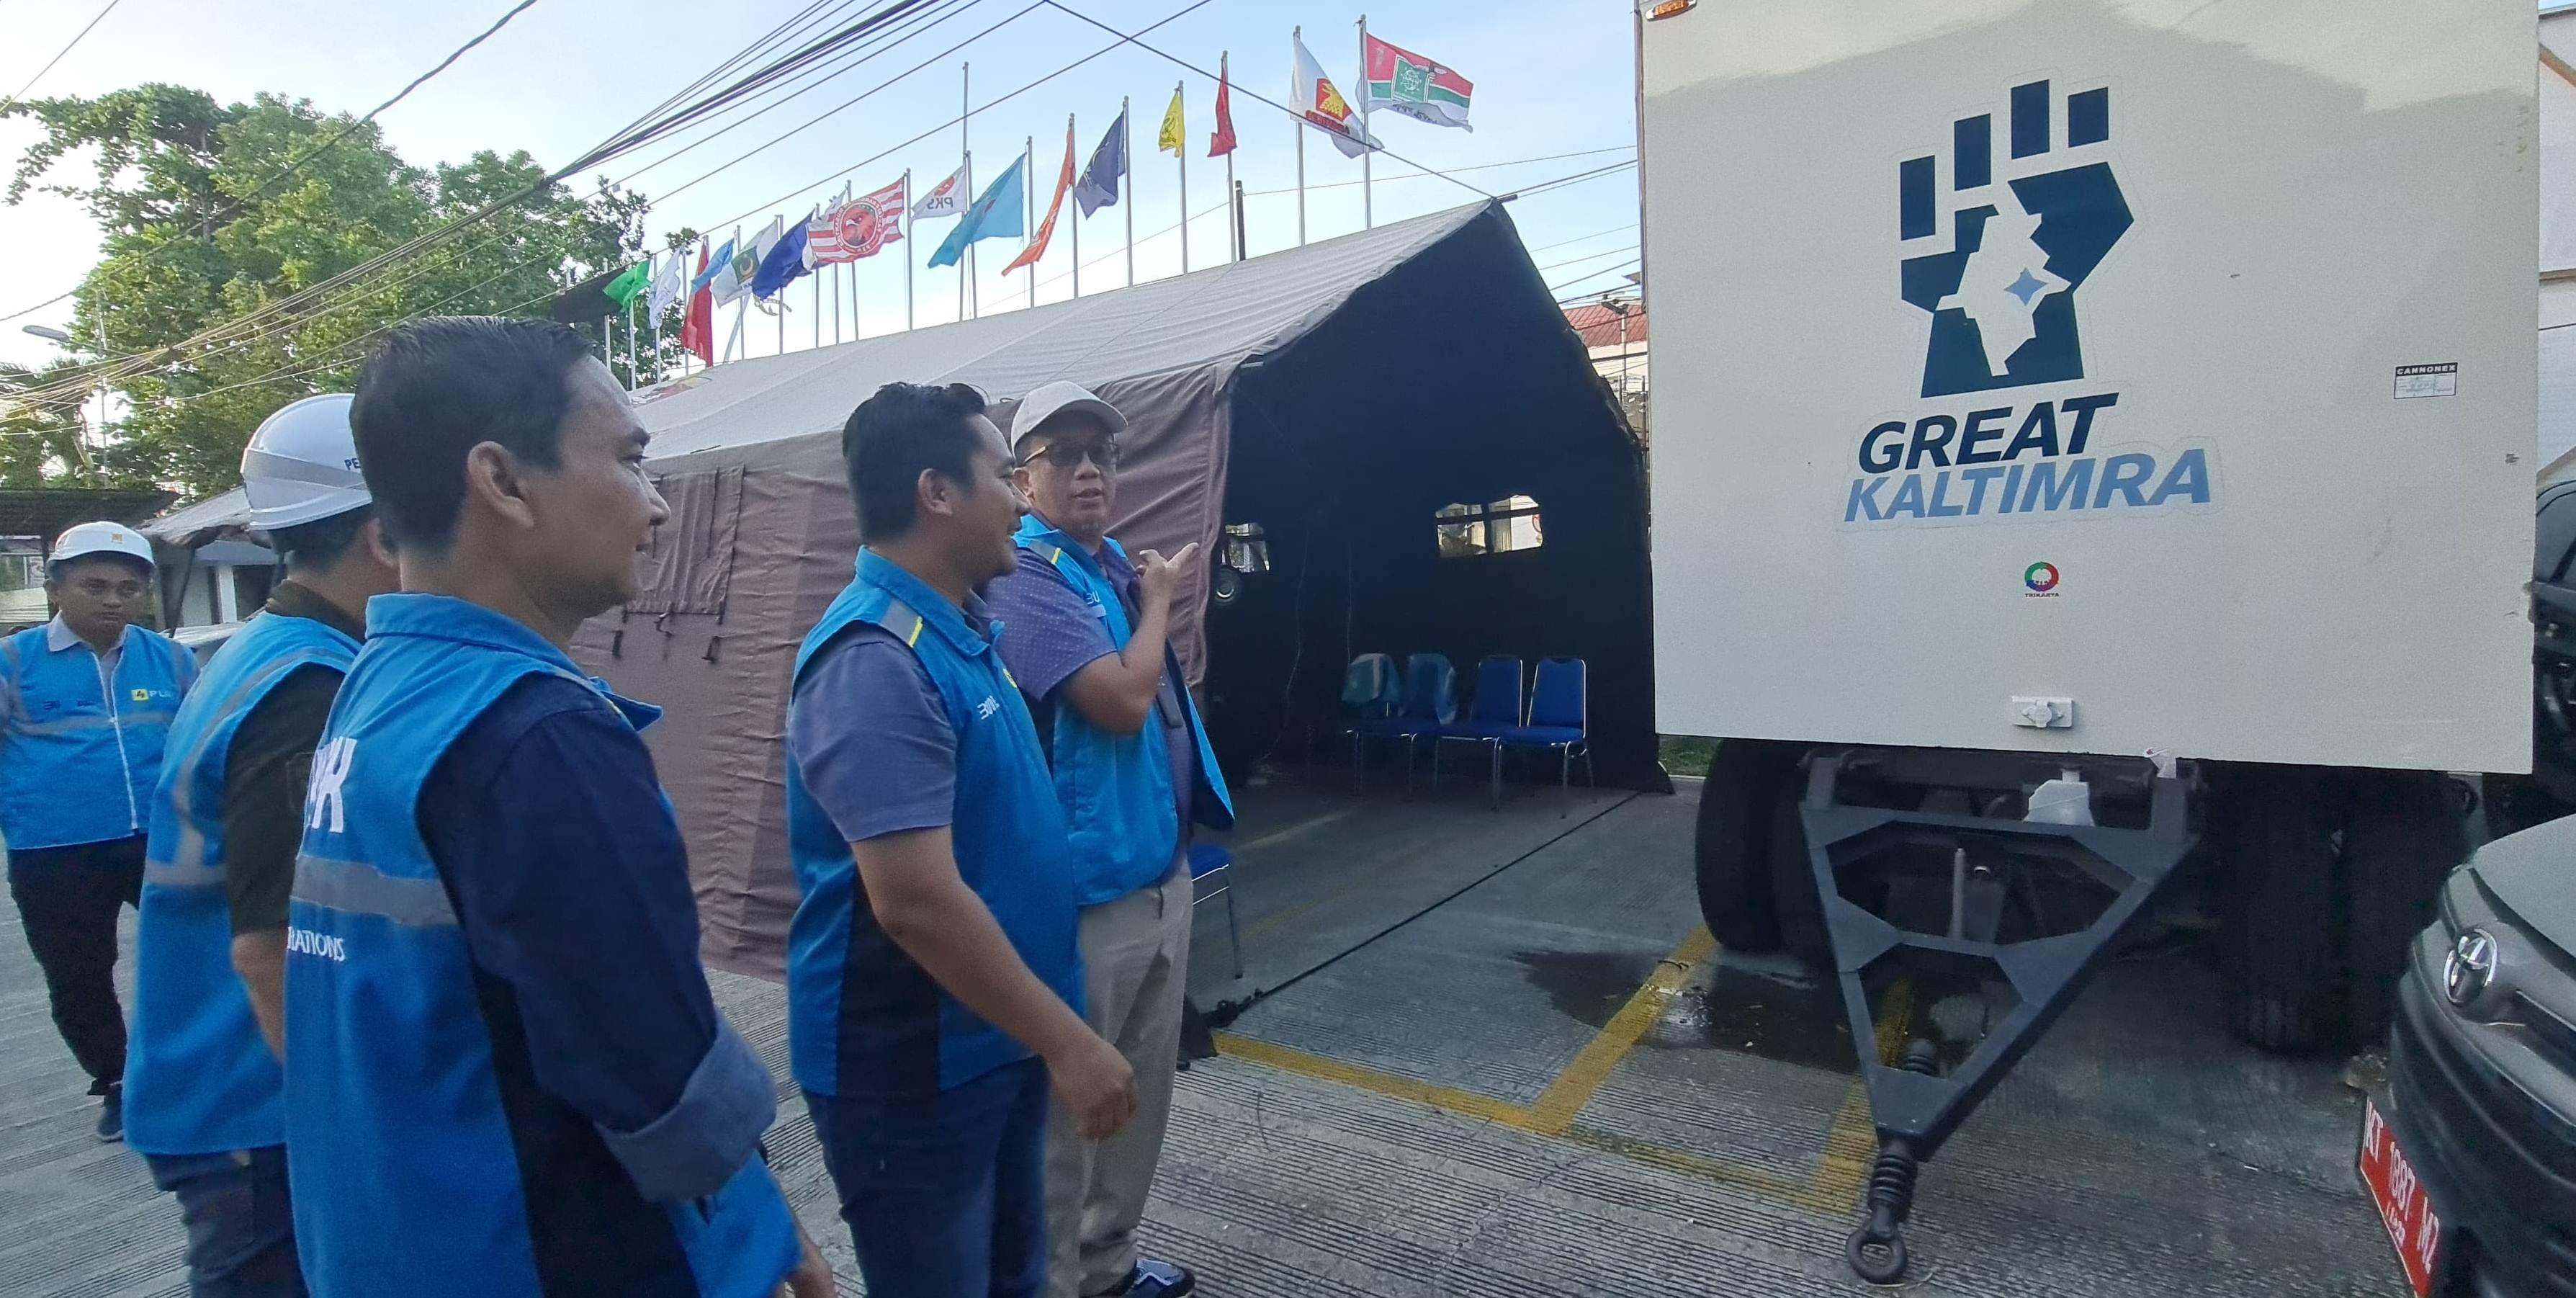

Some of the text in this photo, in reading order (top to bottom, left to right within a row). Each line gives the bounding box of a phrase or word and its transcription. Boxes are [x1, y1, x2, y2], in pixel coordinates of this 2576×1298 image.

[2397, 364, 2456, 375] CANNONEX
[1859, 392, 2119, 474] GREAT
[1844, 448, 2211, 522] KALTIMRA
[2366, 1101, 2384, 1164] KT
[2389, 1141, 2415, 1222] 1887
